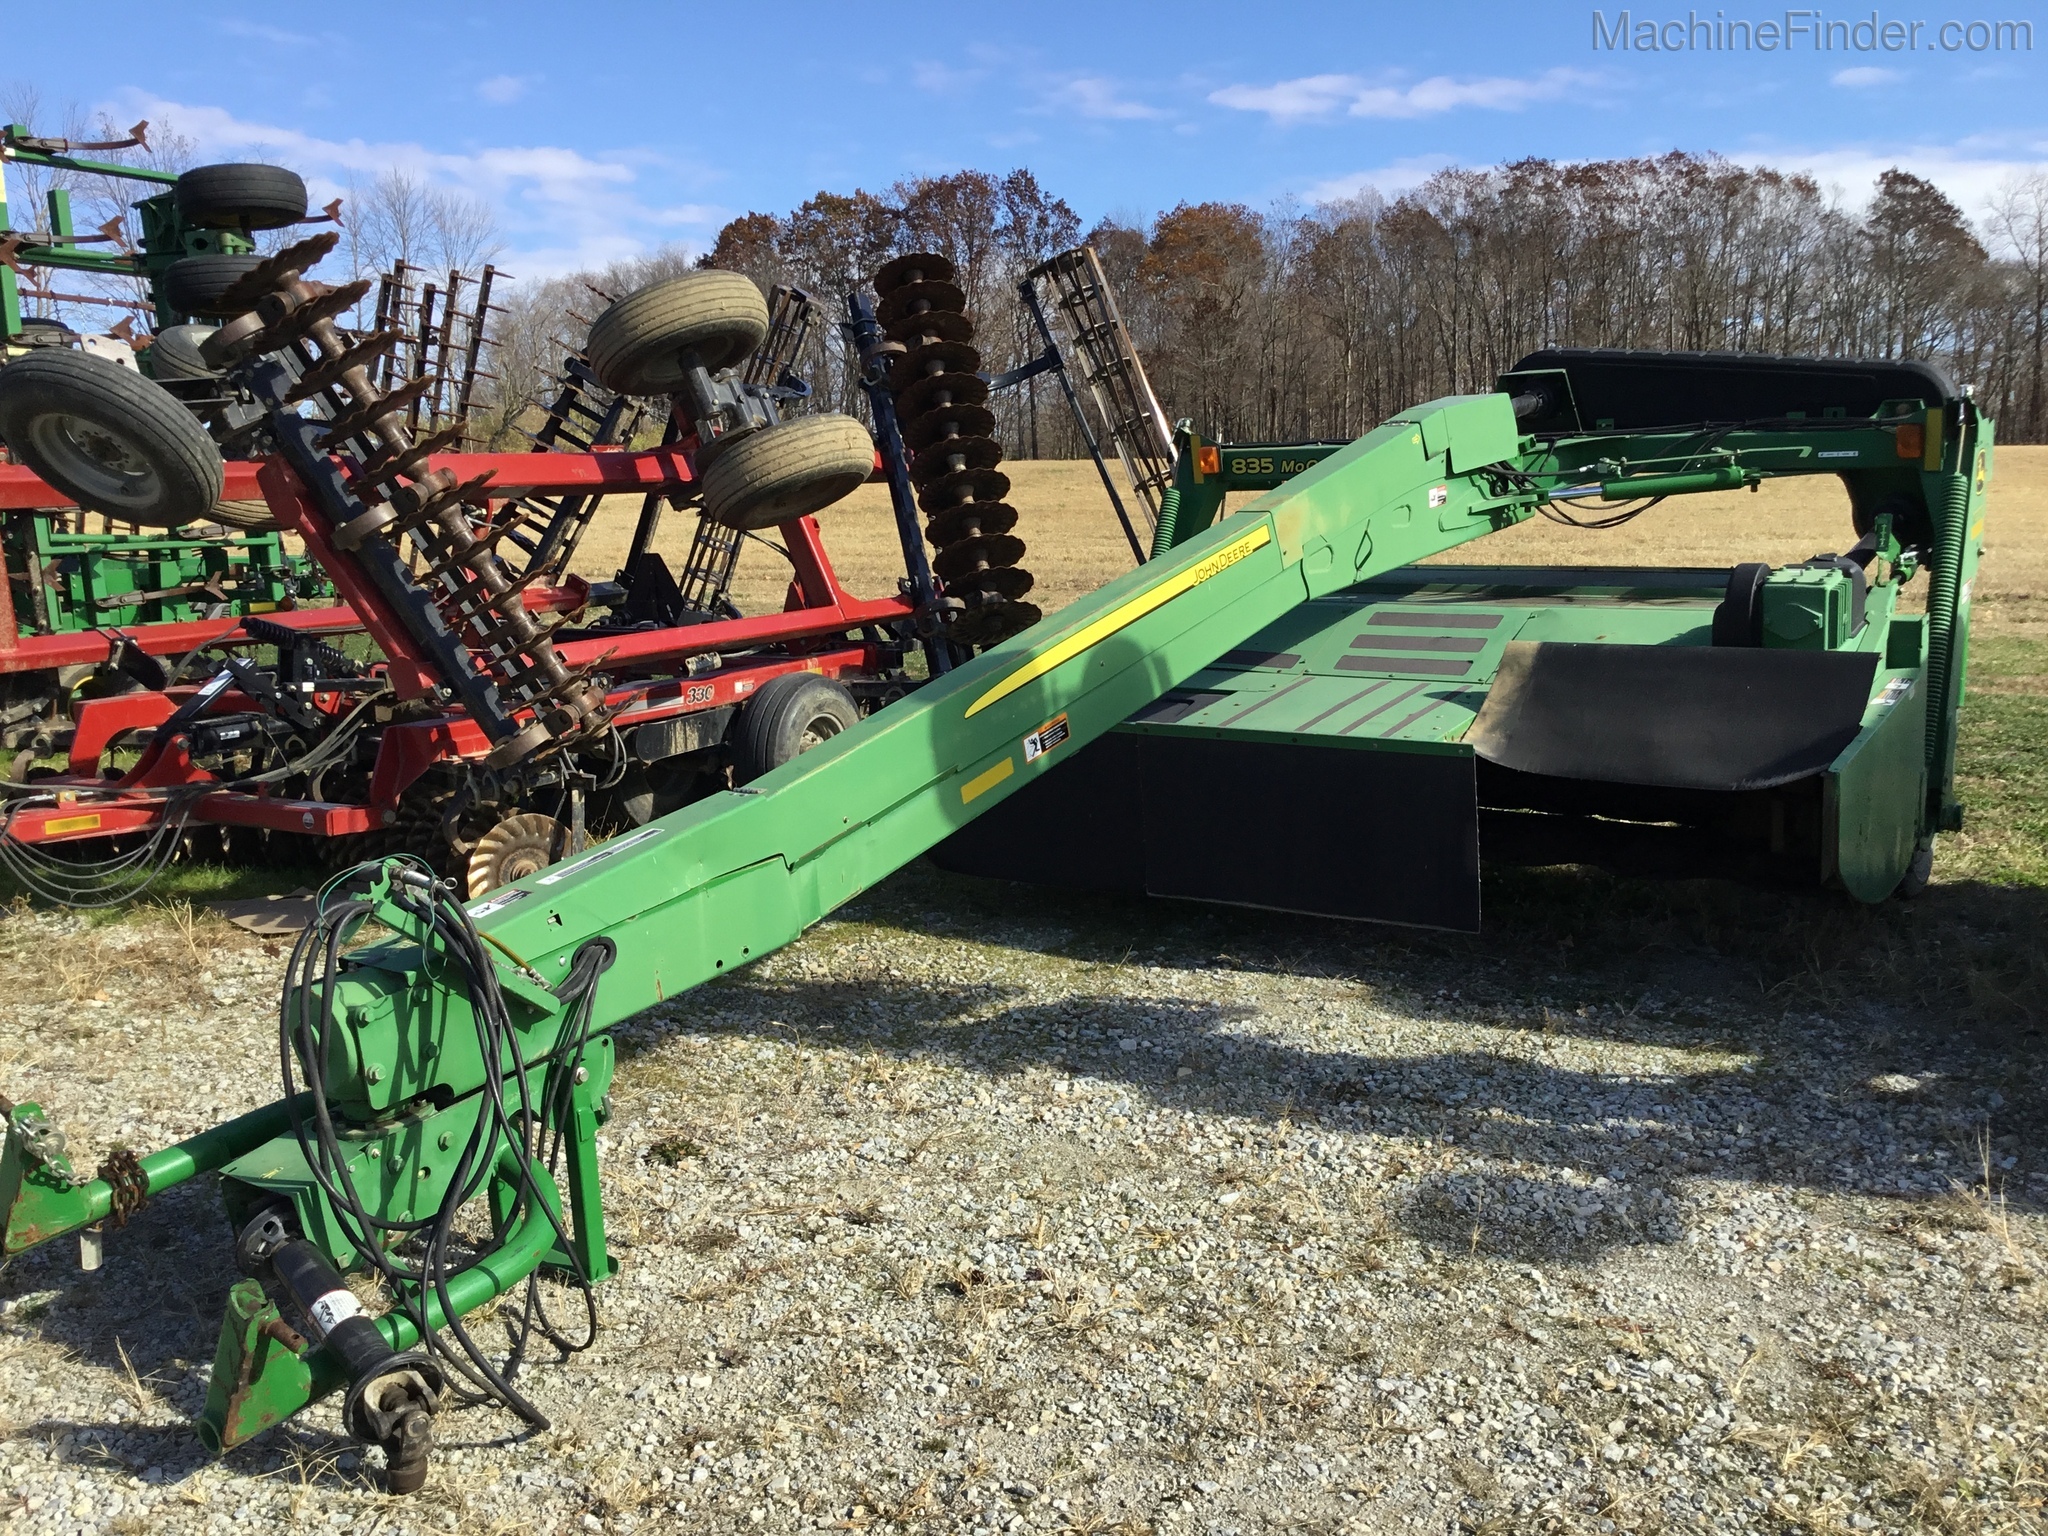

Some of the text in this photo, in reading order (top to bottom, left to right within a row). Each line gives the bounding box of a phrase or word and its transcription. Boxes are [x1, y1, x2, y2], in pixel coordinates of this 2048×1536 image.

[1231, 457, 1275, 475] 835
[1193, 541, 1252, 584] JOHN DEERE
